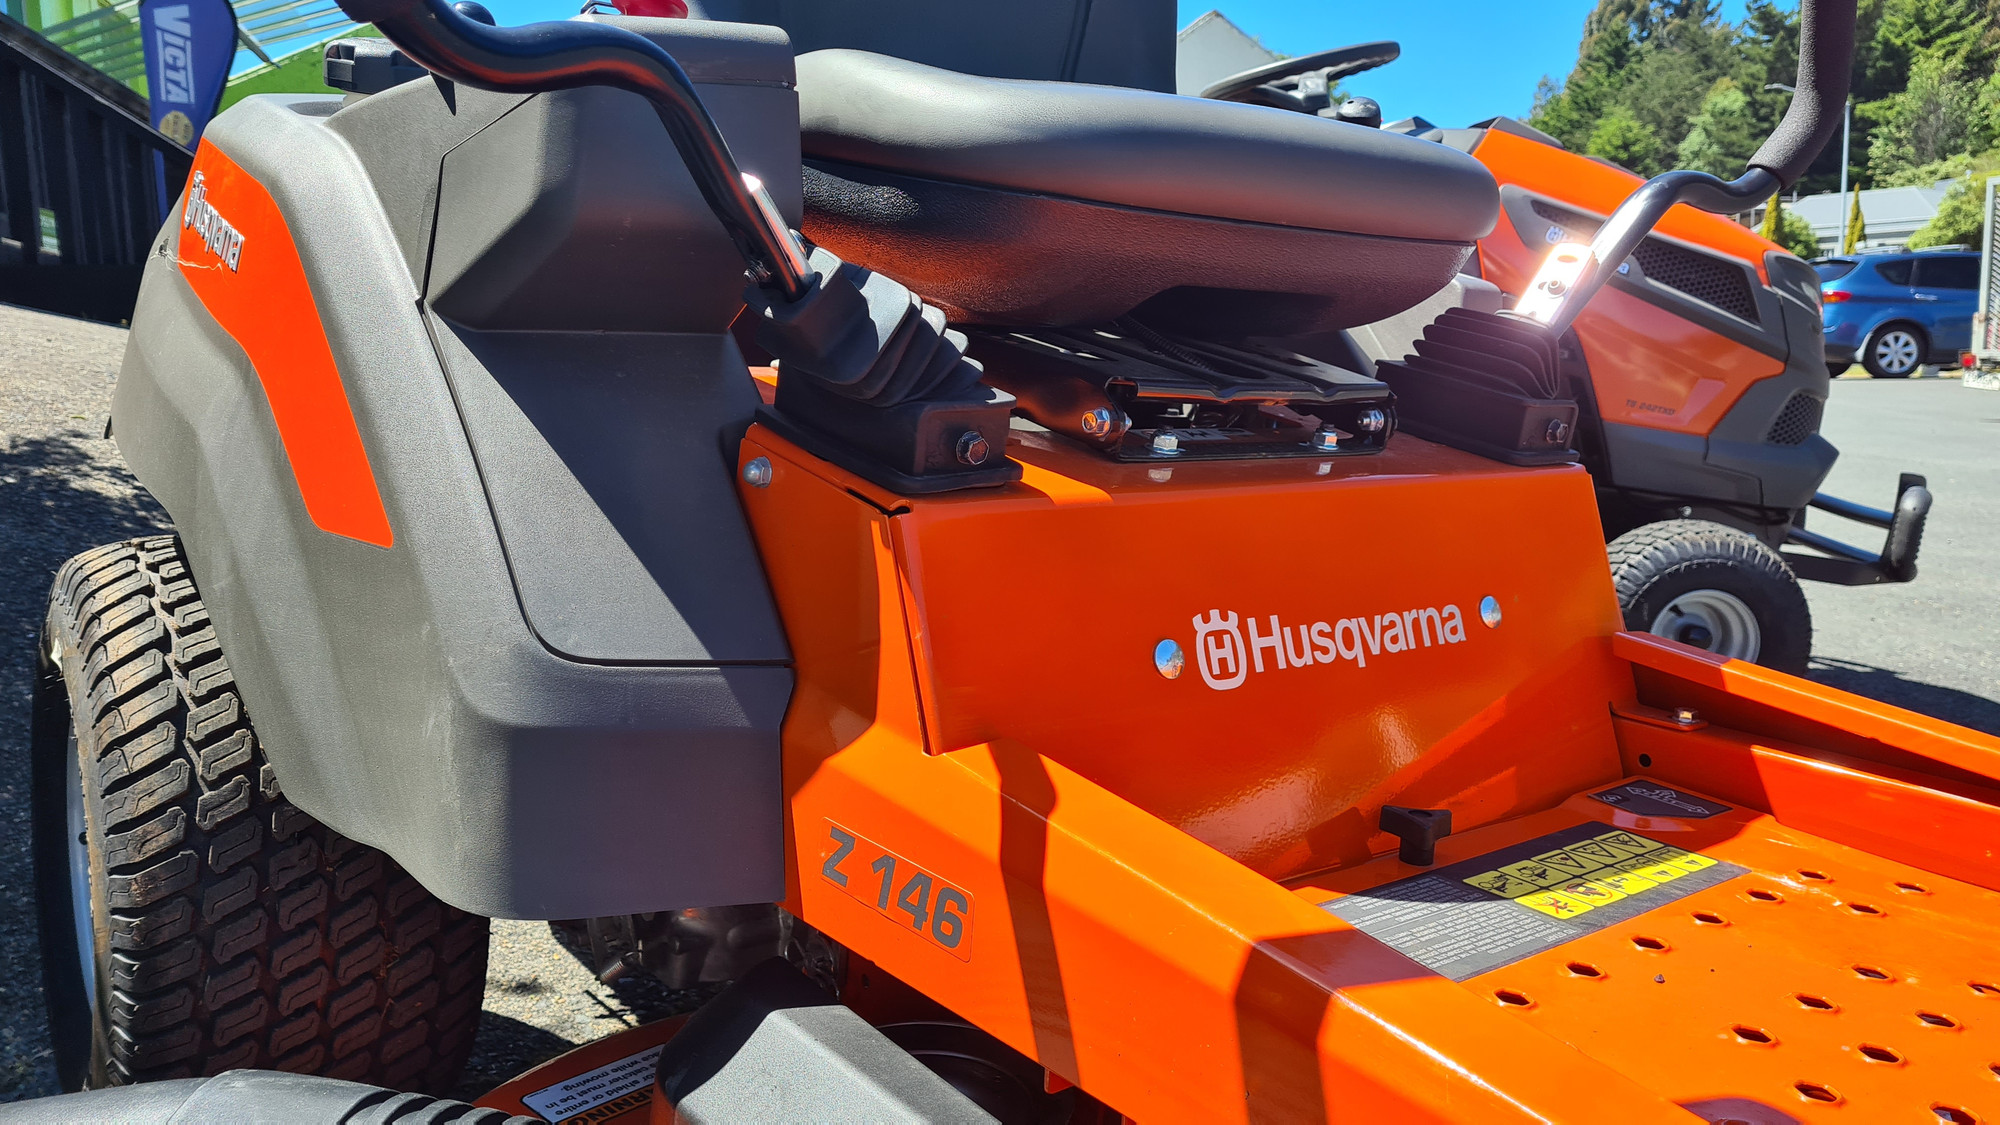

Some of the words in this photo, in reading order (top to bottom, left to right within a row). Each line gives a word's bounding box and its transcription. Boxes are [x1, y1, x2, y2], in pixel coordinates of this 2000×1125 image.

[1247, 604, 1466, 672] Husqvarna
[822, 826, 856, 888] Z
[871, 854, 968, 948] 146
[611, 1060, 641, 1073] while
[608, 1067, 648, 1085] catcher
[576, 1083, 606, 1097] must
[606, 1080, 640, 1096] shield
[555, 1100, 590, 1116] entire
